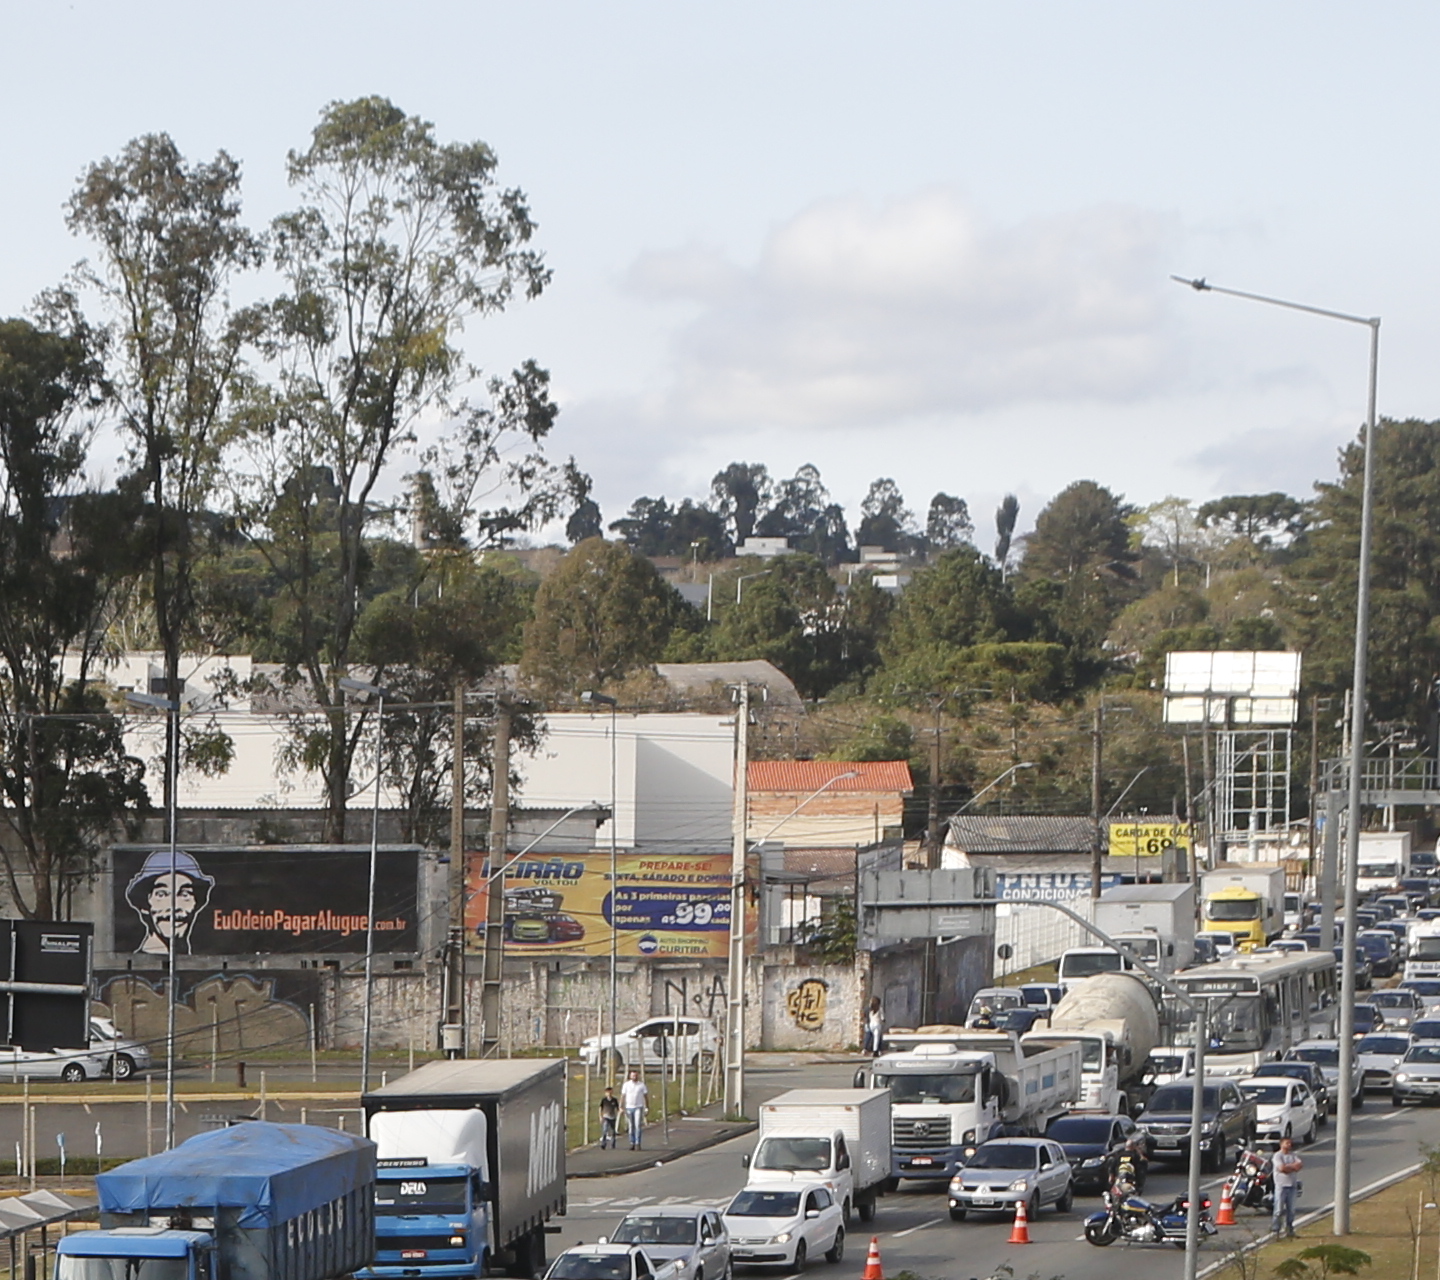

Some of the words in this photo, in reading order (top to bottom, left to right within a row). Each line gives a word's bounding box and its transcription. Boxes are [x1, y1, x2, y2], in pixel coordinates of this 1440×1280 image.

[639, 861, 712, 871] PREPARE-SE!
[213, 909, 406, 936] EuOdeioPagarAlugue.com.br
[659, 945, 709, 954] CURITIBA
